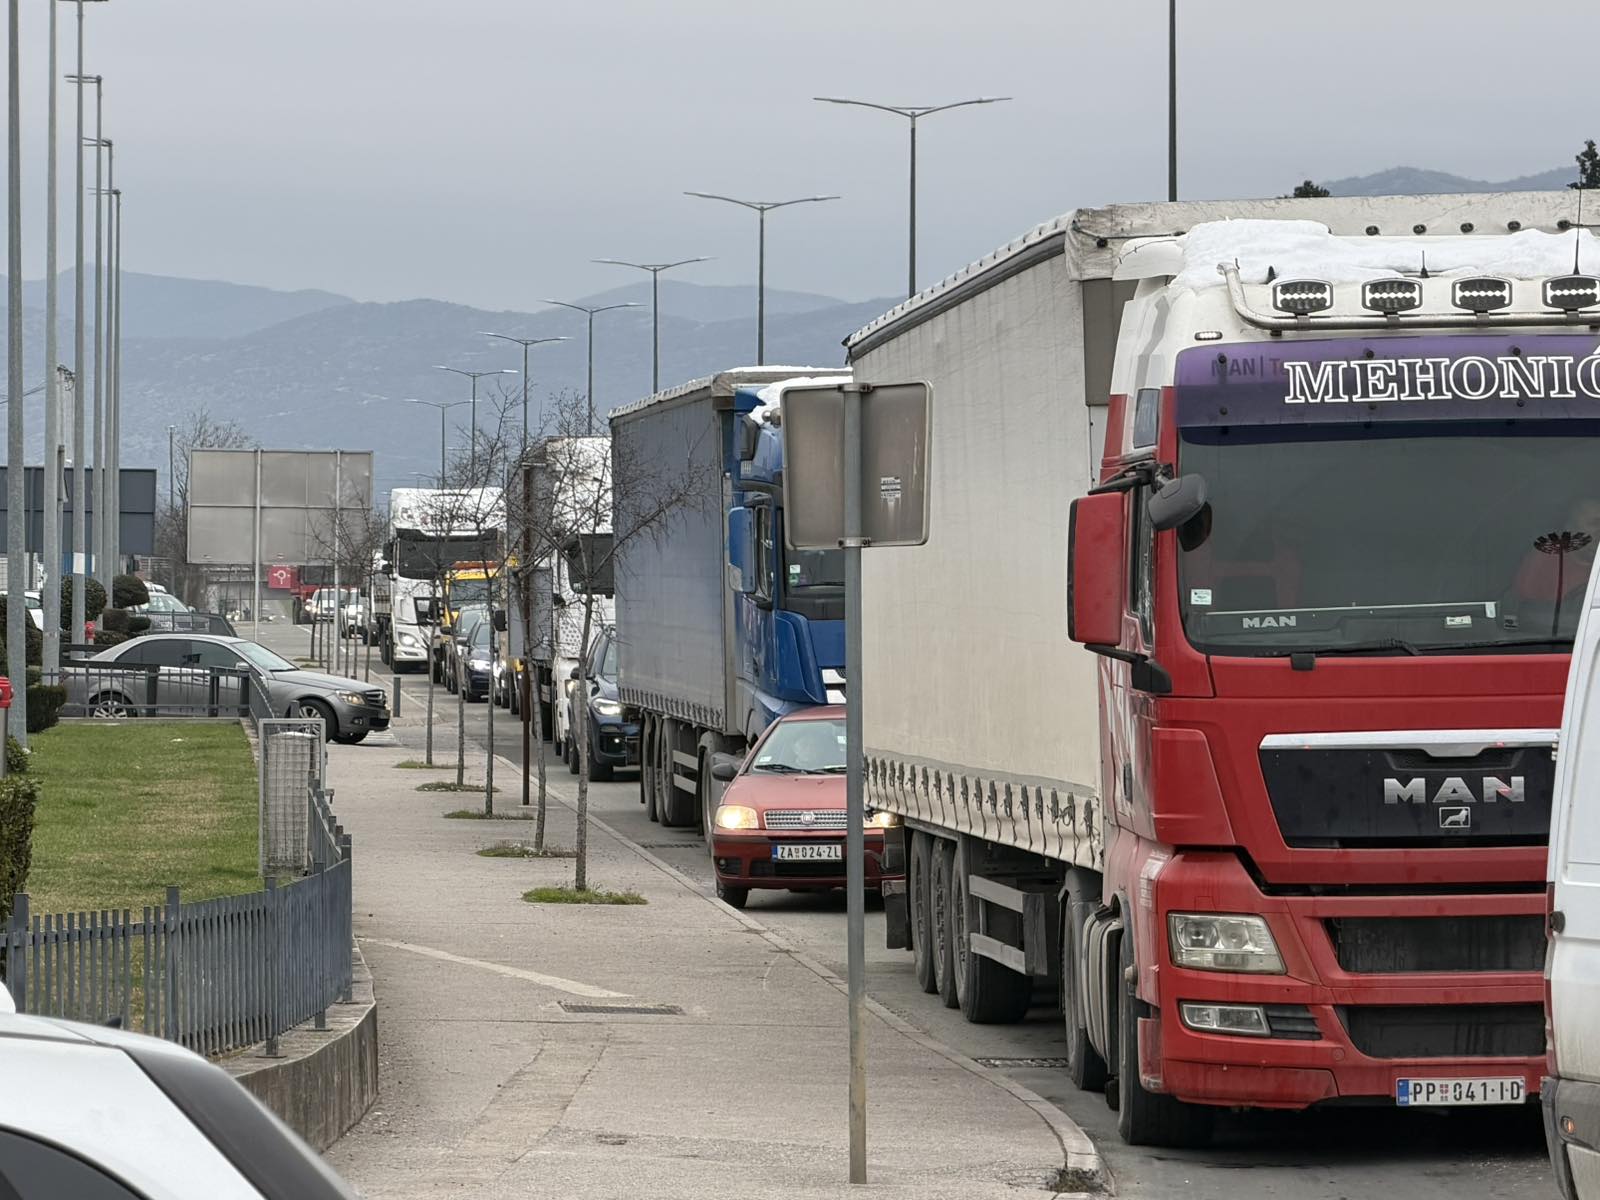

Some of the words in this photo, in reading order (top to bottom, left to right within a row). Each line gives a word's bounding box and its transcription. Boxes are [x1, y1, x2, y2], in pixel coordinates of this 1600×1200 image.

[1242, 615, 1297, 629] MAN
[1383, 776, 1525, 804] MAN
[780, 846, 794, 859] ZA
[1413, 1082, 1436, 1102] PP
